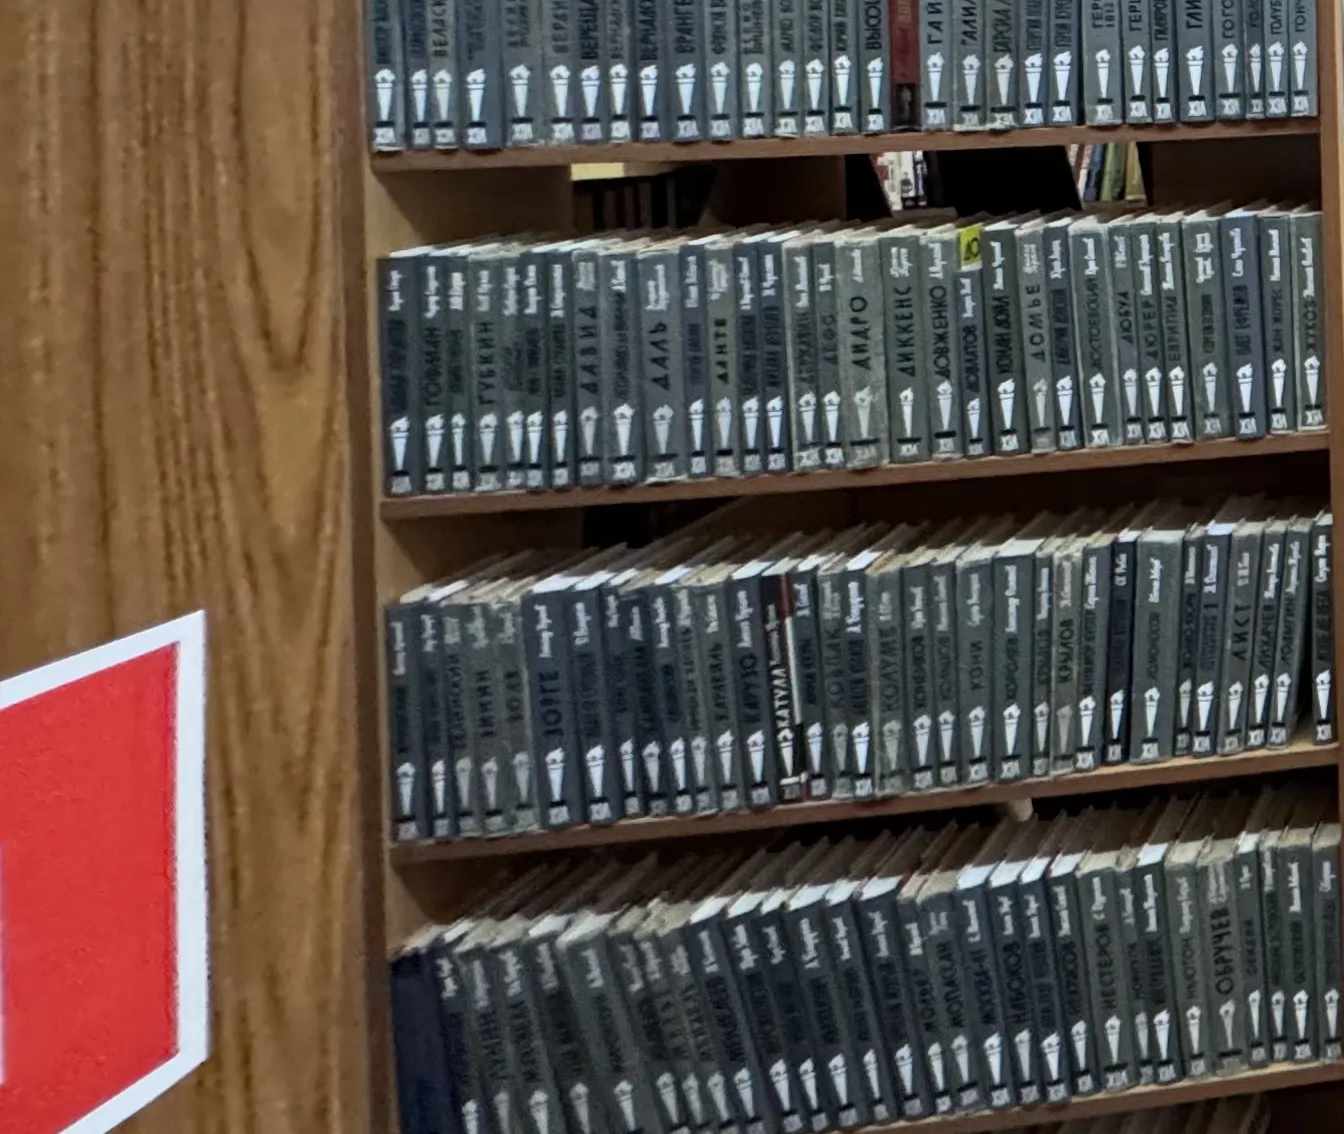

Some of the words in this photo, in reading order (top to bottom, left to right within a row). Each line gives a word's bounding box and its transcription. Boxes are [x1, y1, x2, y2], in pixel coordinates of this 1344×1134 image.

[579, 305, 597, 395] ДАВИД
[650, 321, 669, 392] ДАЛЬ
[715, 318, 728, 385] ДАНТЕ
[849, 295, 870, 372] ДИДРО
[895, 284, 916, 378] ДИККЕНС
[930, 285, 951, 380] ДОВЖЕНКО
[1026, 284, 1046, 363] ДОМЬЕ
[1142, 299, 1158, 360] ДЮРЕР
[478, 321, 495, 406] ГУБКИН
[970, 640, 984, 691] КОНИ
[1059, 618, 1073, 684] КРЫЛОВ
[1232, 603, 1250, 662] ЛИСТ
[1256, 603, 1272, 672] ЛИХАЧЕВ
[1211, 907, 1235, 996] ОБРУЧЕВ
